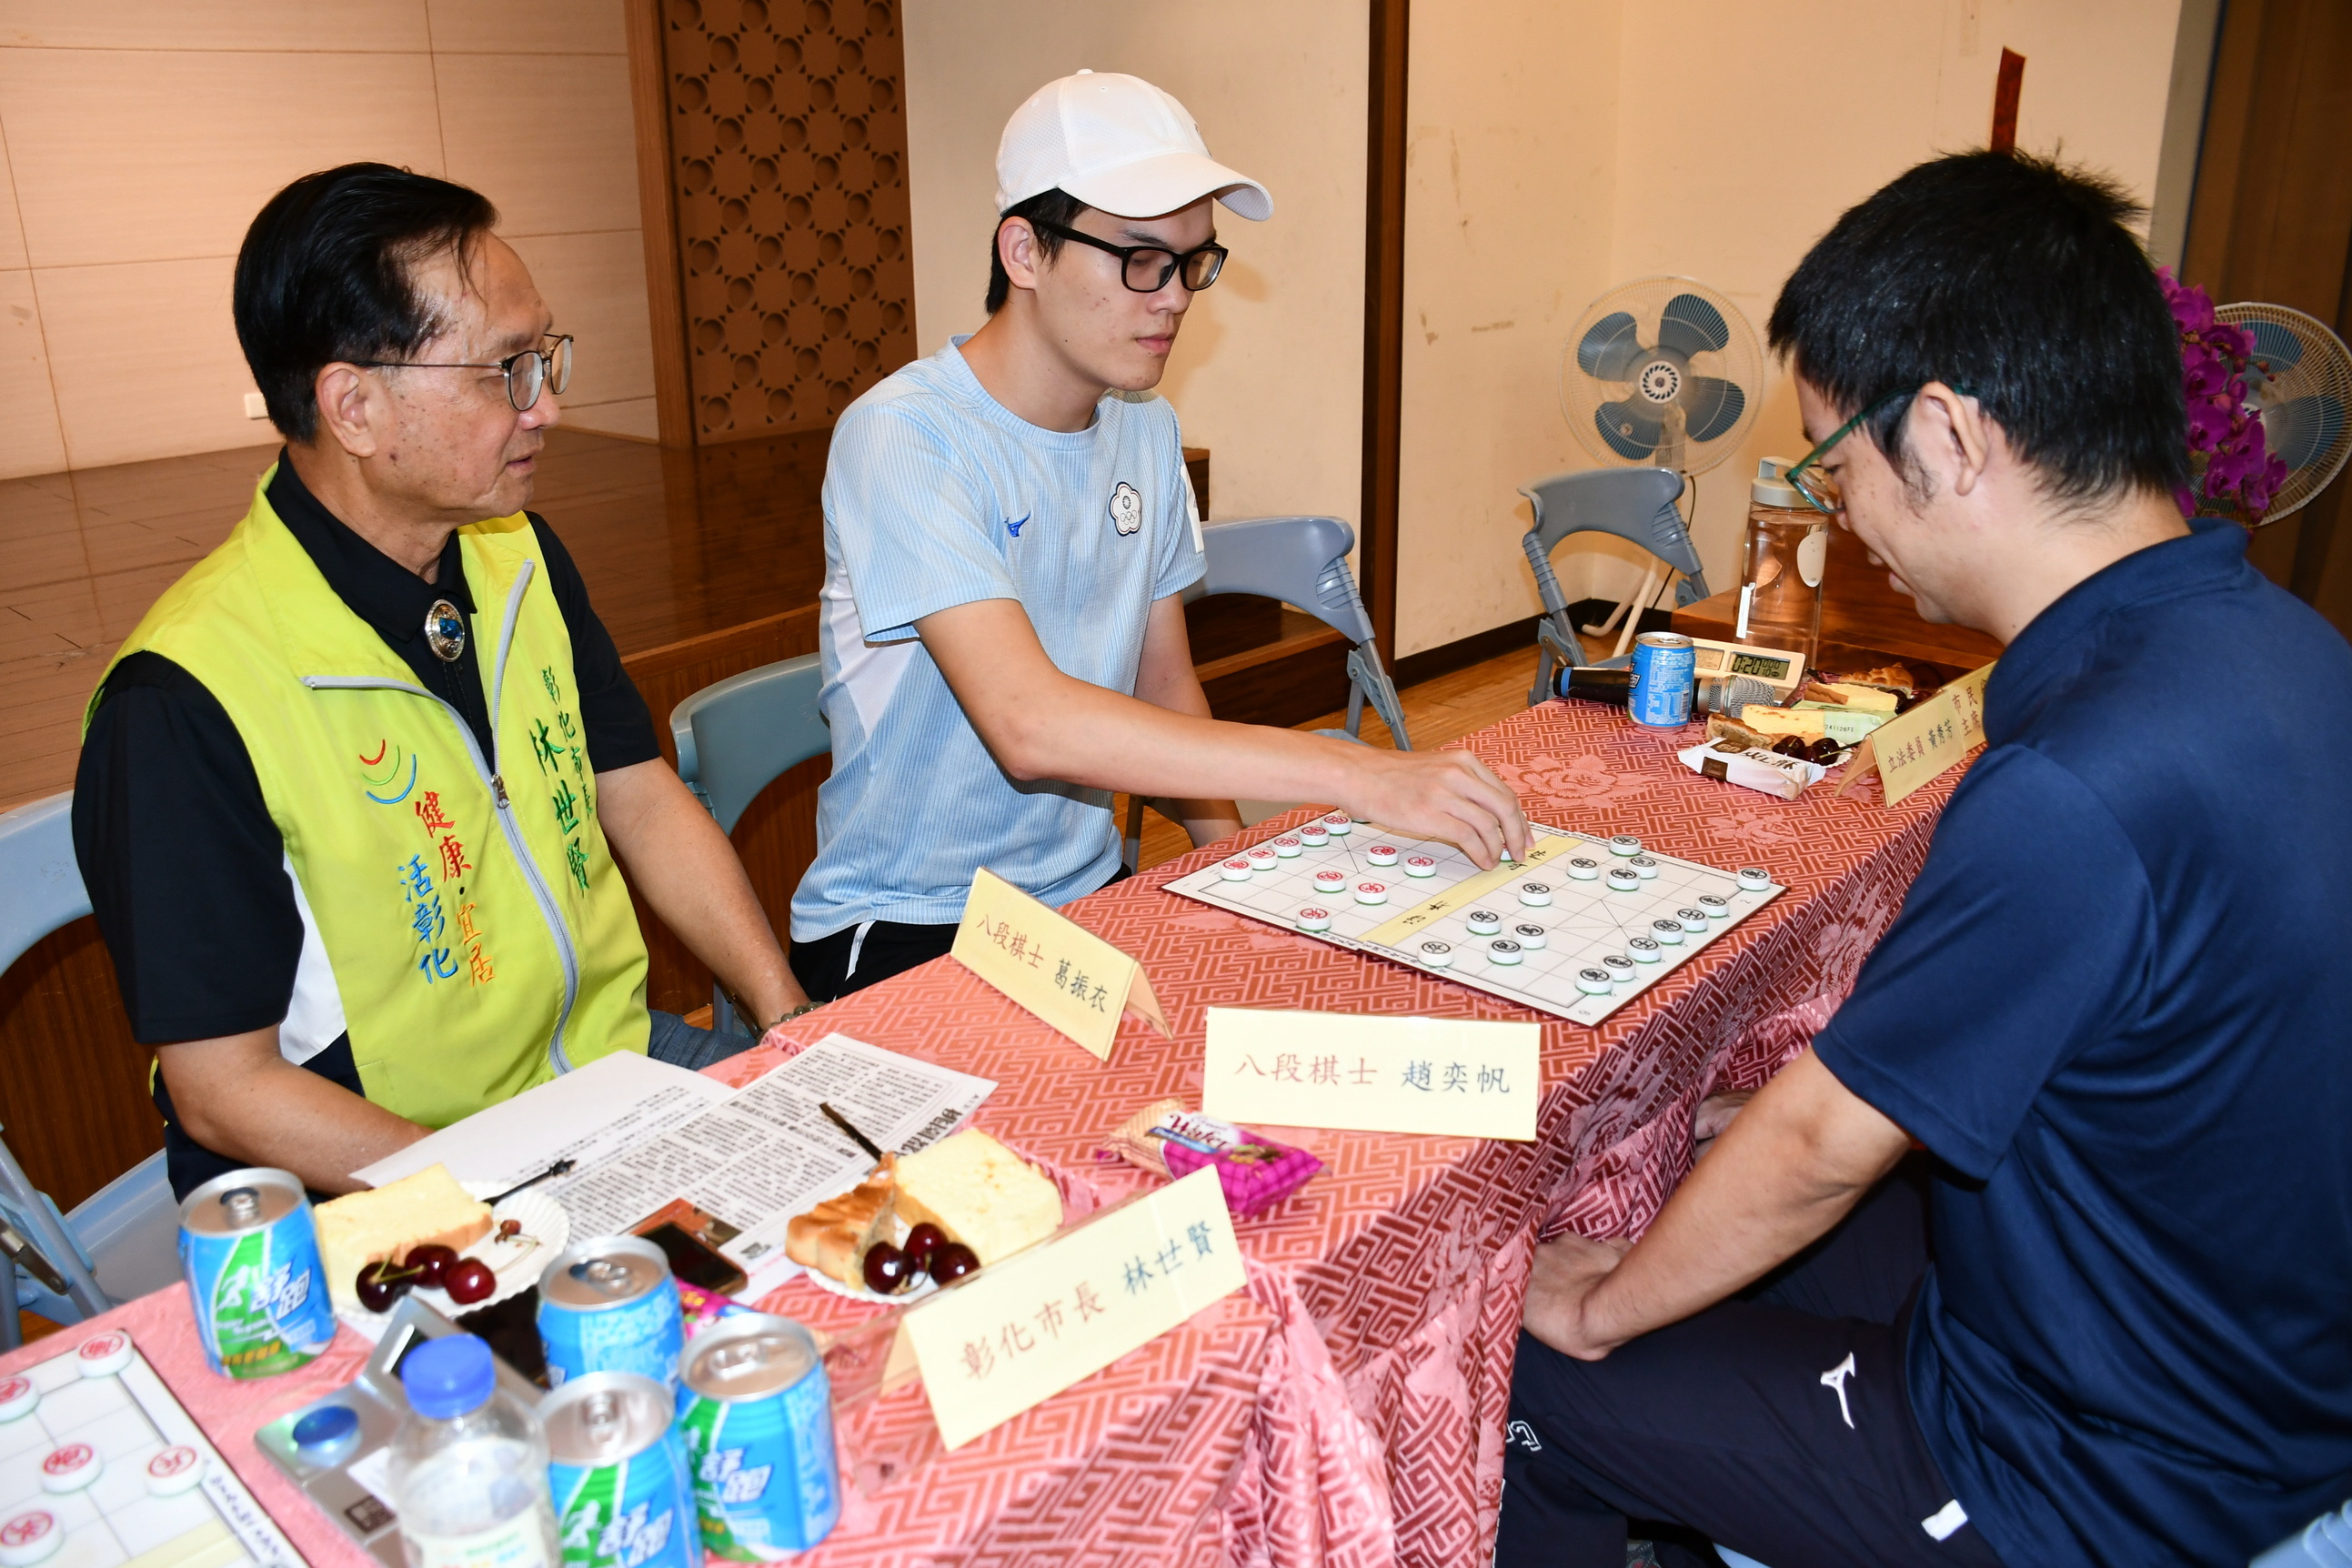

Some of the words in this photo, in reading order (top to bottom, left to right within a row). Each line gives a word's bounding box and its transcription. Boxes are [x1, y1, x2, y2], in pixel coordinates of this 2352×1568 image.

[1732, 655, 1763, 676] 0:20
[542, 665, 593, 820] 彰化市長
[1888, 736, 1925, 773] 立法委員
[529, 718, 589, 898] 林世賢
[398, 853, 458, 985] 活彰化
[976, 914, 1044, 969] 八段棋士
[1054, 958, 1108, 1012] 葛振衣
[1234, 1053, 1379, 1086] 八段棋士
[1400, 1060, 1511, 1096] 趙奕帆
[961, 1281, 1106, 1381] 彰化市長
[1123, 1221, 1212, 1295] 林世賢
